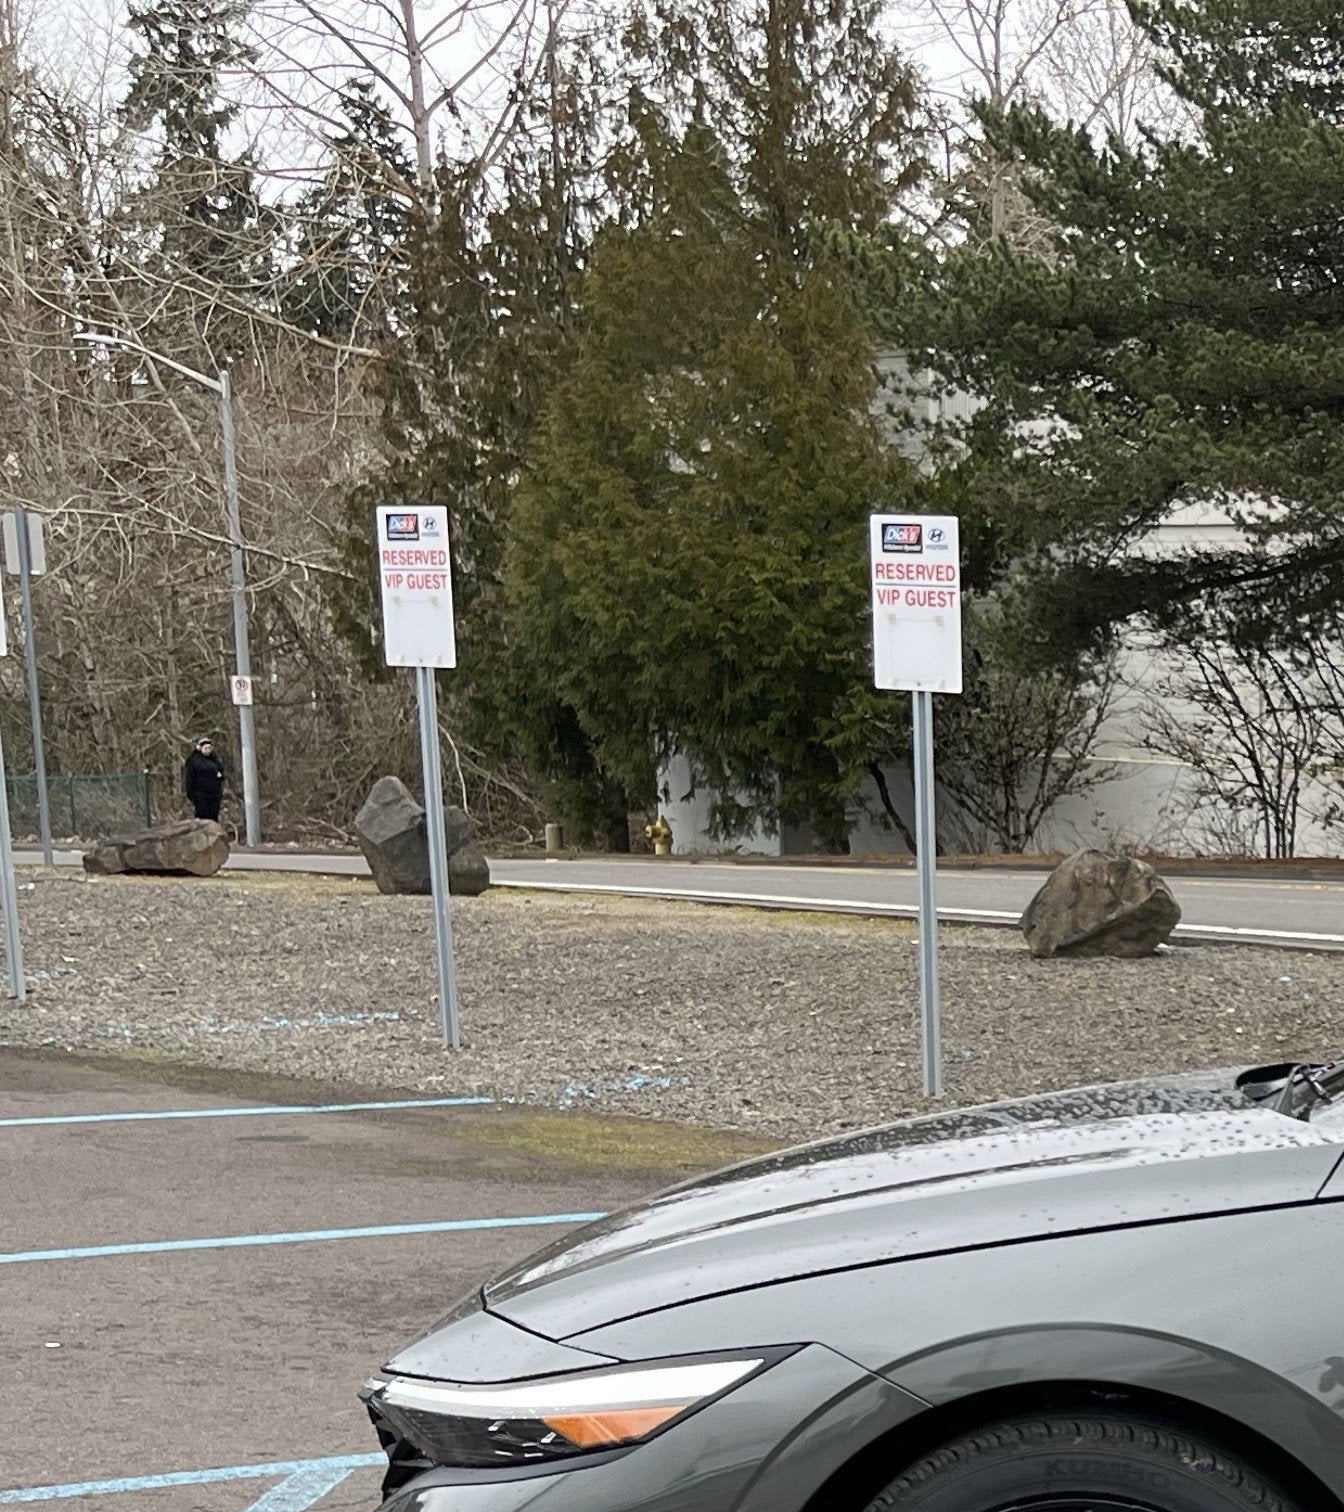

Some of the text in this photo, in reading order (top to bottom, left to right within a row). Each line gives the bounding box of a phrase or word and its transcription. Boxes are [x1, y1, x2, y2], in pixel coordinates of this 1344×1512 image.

[383, 550, 447, 566] RESERVED
[876, 563, 956, 582] RESERVED
[385, 574, 447, 590] VIP GUEST
[877, 588, 956, 608] VIP GUEST
